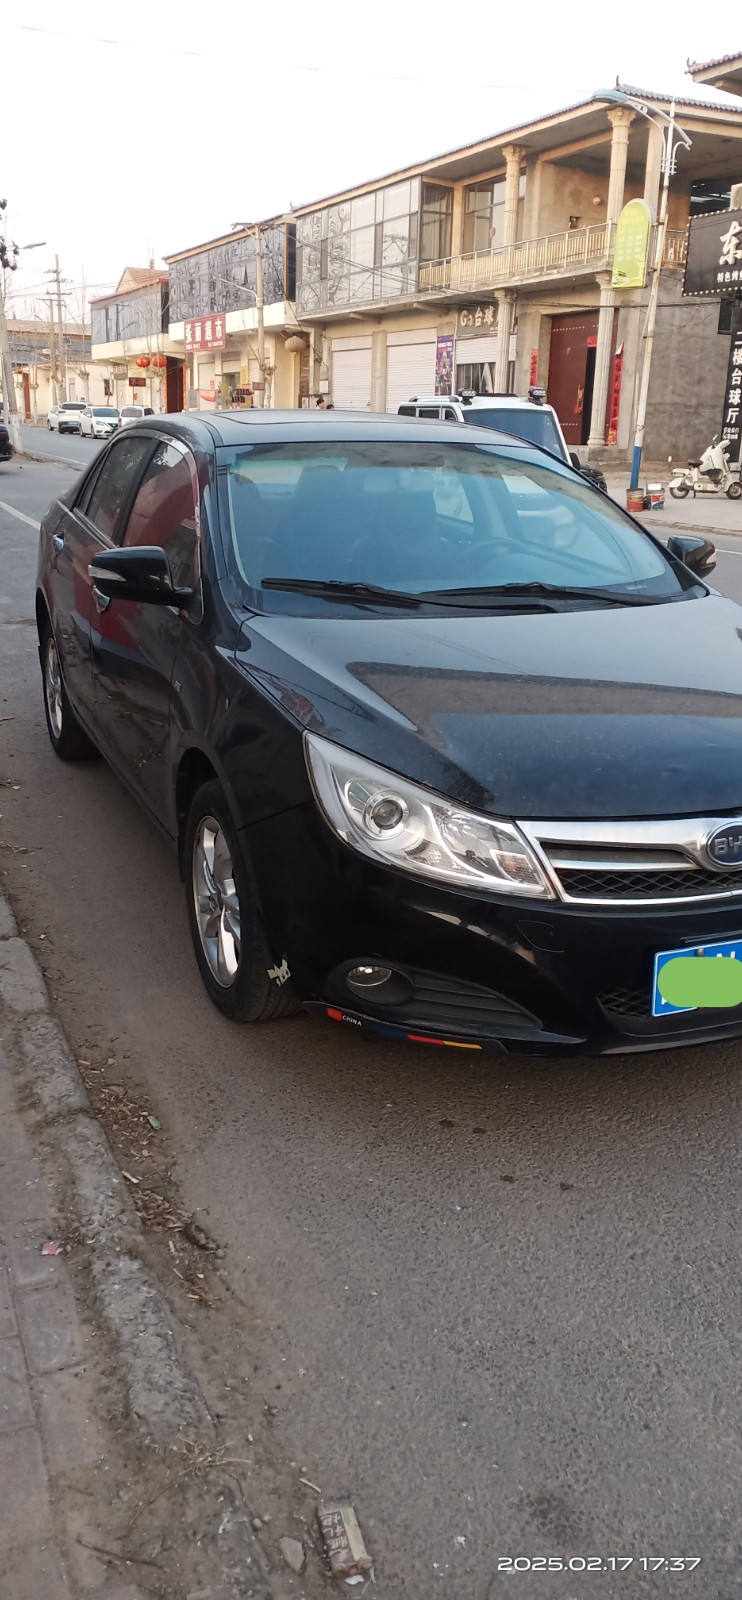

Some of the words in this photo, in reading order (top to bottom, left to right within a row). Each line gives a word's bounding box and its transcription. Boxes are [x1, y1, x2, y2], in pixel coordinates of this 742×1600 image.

[726, 331, 742, 424] 二楼台球厅
[342, 1014, 362, 1026] CHINA
